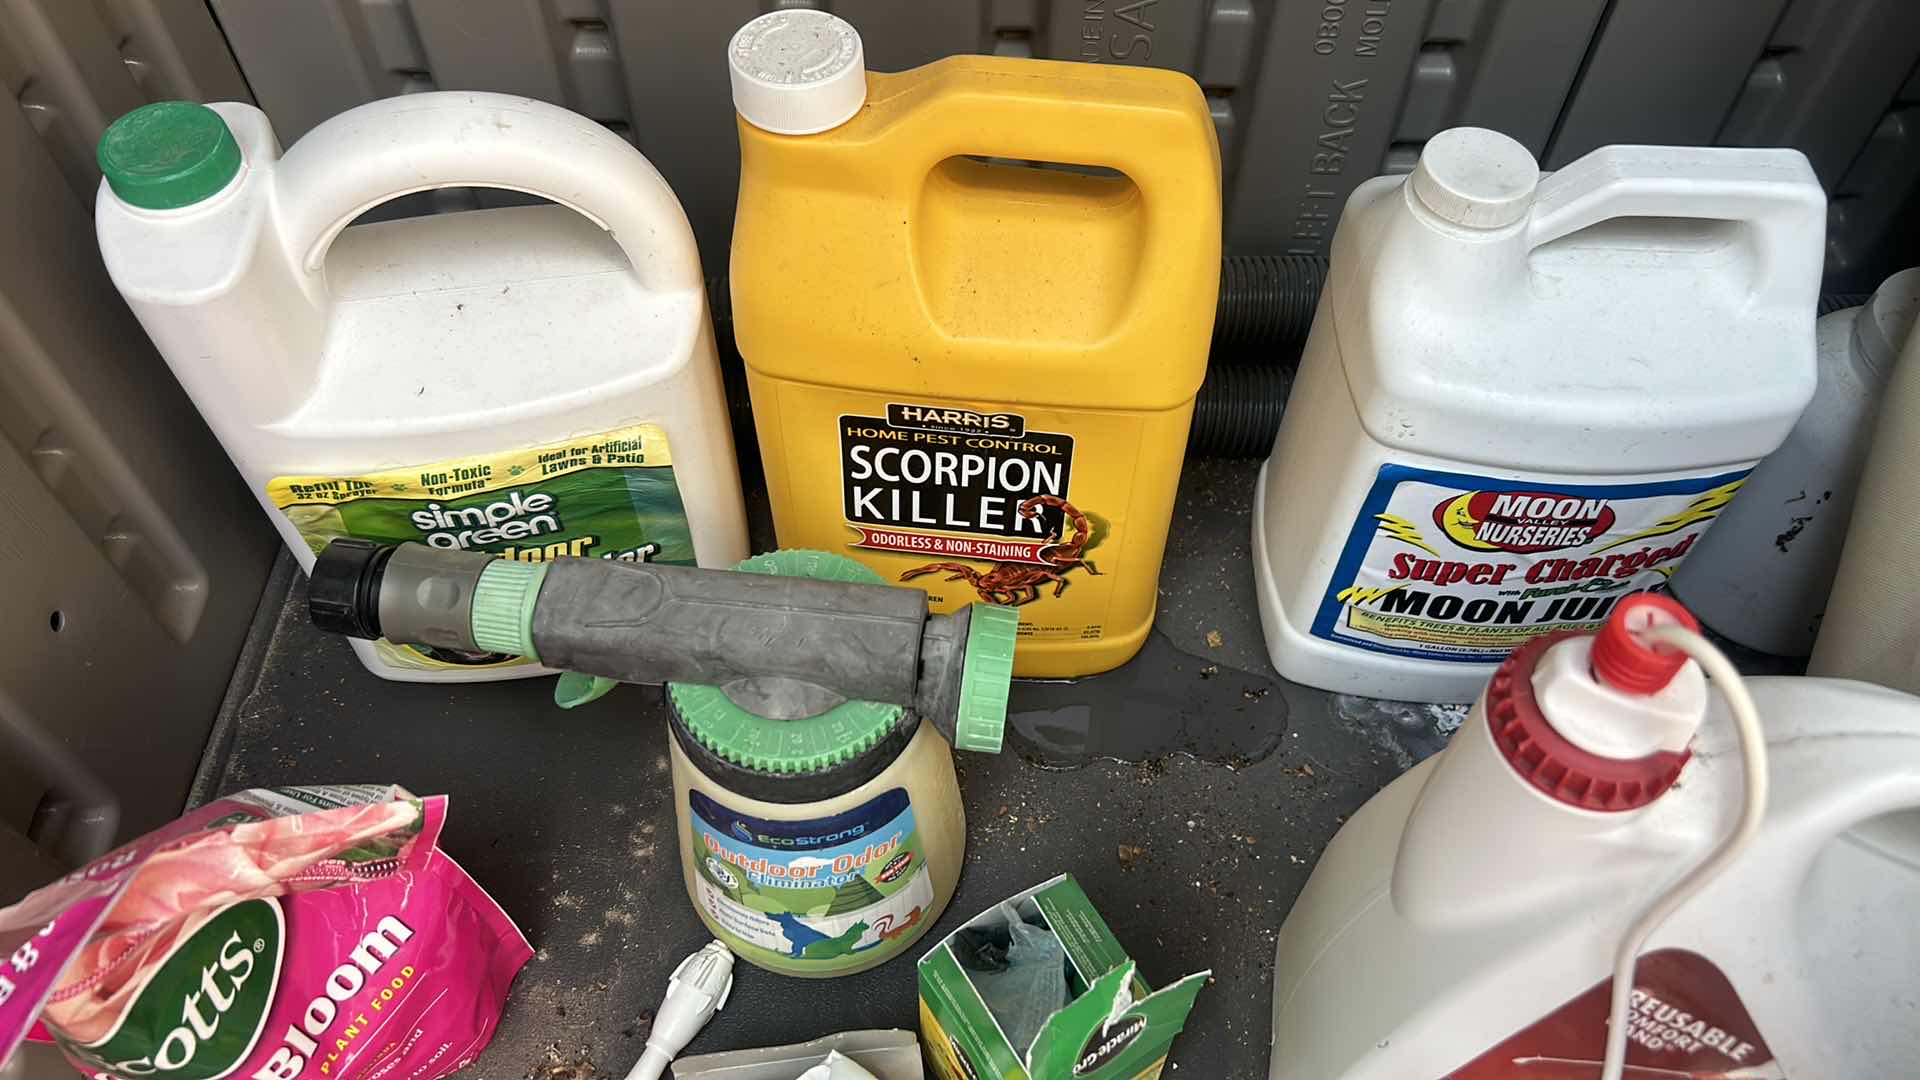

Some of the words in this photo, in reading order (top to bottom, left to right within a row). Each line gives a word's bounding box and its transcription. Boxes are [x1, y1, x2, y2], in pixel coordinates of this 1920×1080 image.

[1354, 0, 1392, 58] MOL
[1310, 77, 1369, 176] BACK
[901, 406, 1011, 430] HARRIS
[537, 449, 567, 464] Ideal
[570, 446, 589, 457] for
[591, 435, 643, 454] Artificial
[847, 426, 909, 441] HOME
[914, 433, 961, 446] PEST
[965, 437, 1064, 456] CONTROL
[420, 464, 492, 487] Non-Toxic
[541, 457, 587, 476] Lawns
[591, 454, 602, 465] &
[606, 452, 645, 465] Patio
[850, 445, 1062, 496] SCORPION
[331, 488, 378, 501] Sprayer
[411, 491, 553, 531] simple
[852, 485, 1043, 534] KILLER
[1489, 494, 1609, 520] MOON
[427, 515, 559, 552] green
[1475, 521, 1592, 548] NURSERIES
[1516, 518, 1570, 527] VALLEY
[871, 532, 932, 550] ODORLESS
[934, 537, 944, 551] &
[945, 538, 1032, 559] NON-STAINING
[1388, 553, 1517, 587] Super
[1525, 533, 1700, 585] Charged
[1359, 611, 1419, 629] BENEFITS
[1418, 619, 1456, 633] TREES
[1466, 622, 1514, 635] PLANTS
[1379, 588, 1538, 625] MOON
[757, 824, 866, 847] EcoStrong
[703, 832, 824, 880] Outdoor
[832, 831, 904, 875] Odor
[746, 869, 861, 889] Eliminator
[250, 915, 415, 1080] Bloom
[320, 1013, 369, 1075] PLANT
[370, 965, 416, 1012] FOOD
[1627, 1009, 1704, 1053] OMFORT
[1630, 988, 1756, 1063] REUSABLE
[401, 1028, 424, 1056] and
[1072, 1014, 1148, 1077] Miracle-Gro
